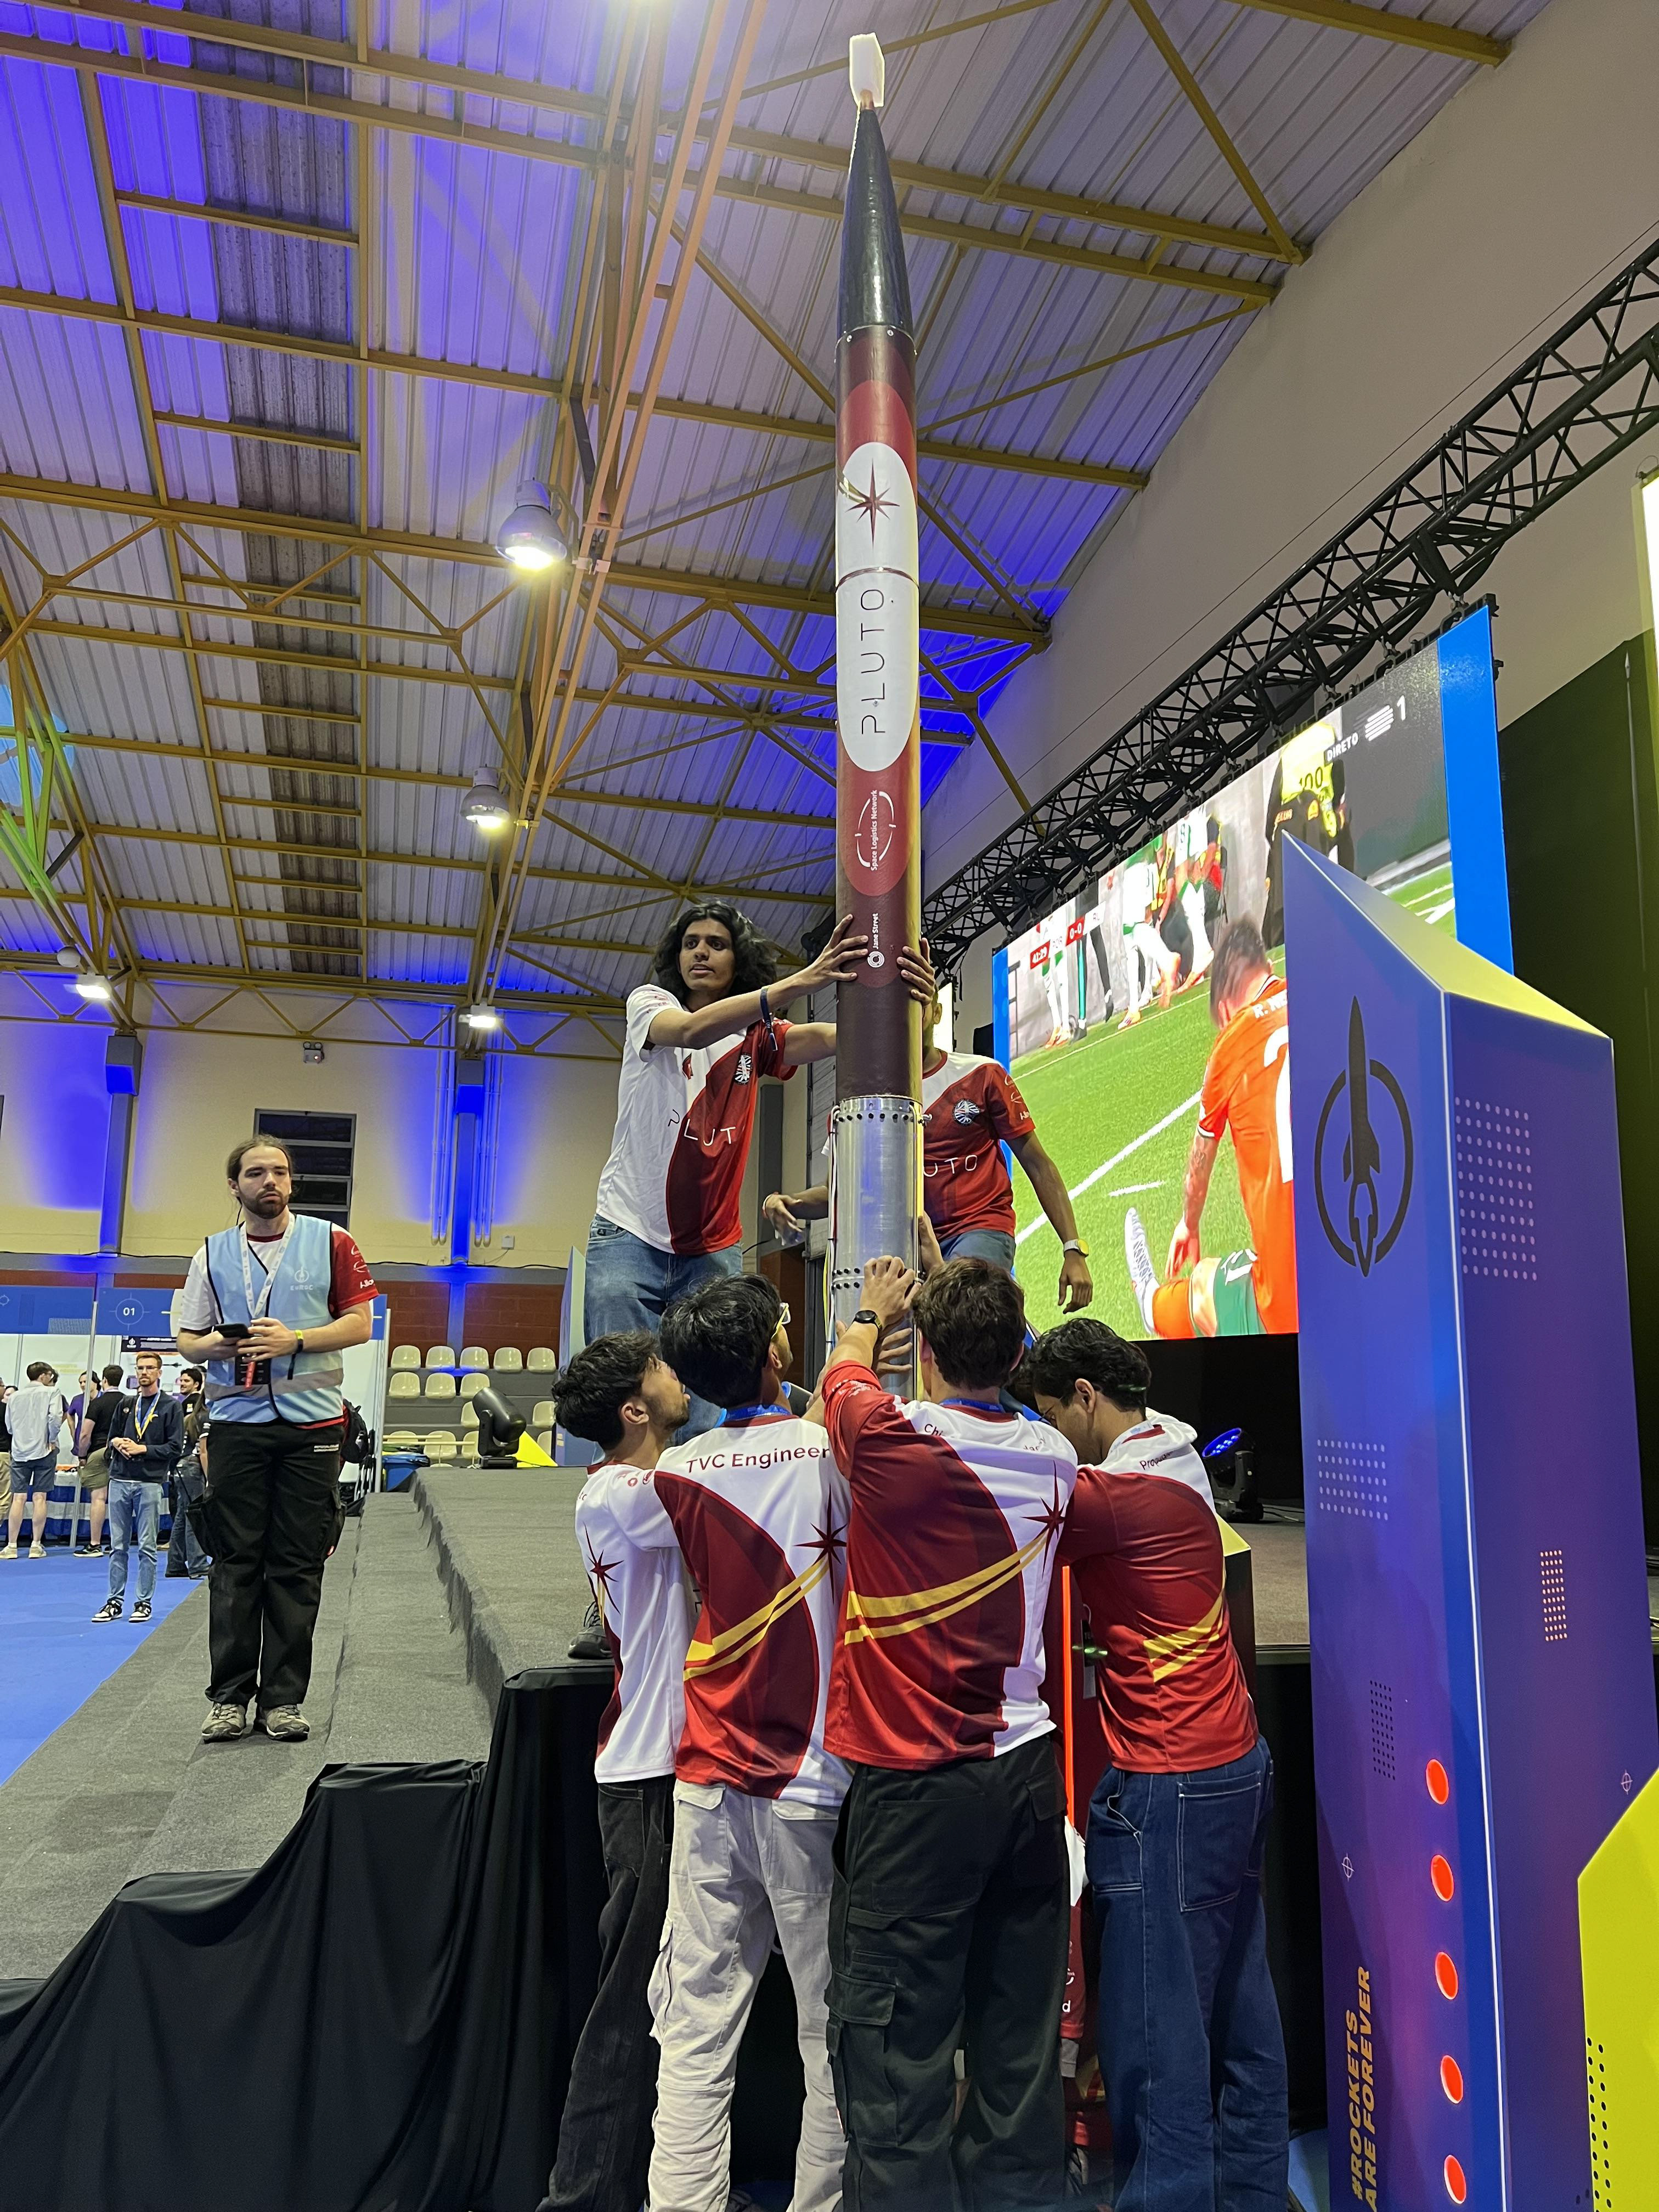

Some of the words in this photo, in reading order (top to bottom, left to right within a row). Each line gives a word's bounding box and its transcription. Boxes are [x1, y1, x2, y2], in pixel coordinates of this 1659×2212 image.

[861, 588, 885, 735] PLUTO
[1396, 695, 1407, 721] 1
[1327, 732, 1359, 761] DIRETO
[1070, 922, 1082, 939] 0-0
[123, 1307, 136, 1316] 01
[686, 1454, 725, 1474] TVC
[732, 1446, 830, 1469] Engineer
[1358, 1966, 1375, 2135] FOREVER
[1346, 2010, 1363, 2201] #ROCKETS
[1364, 2136, 1377, 2212] ARE
